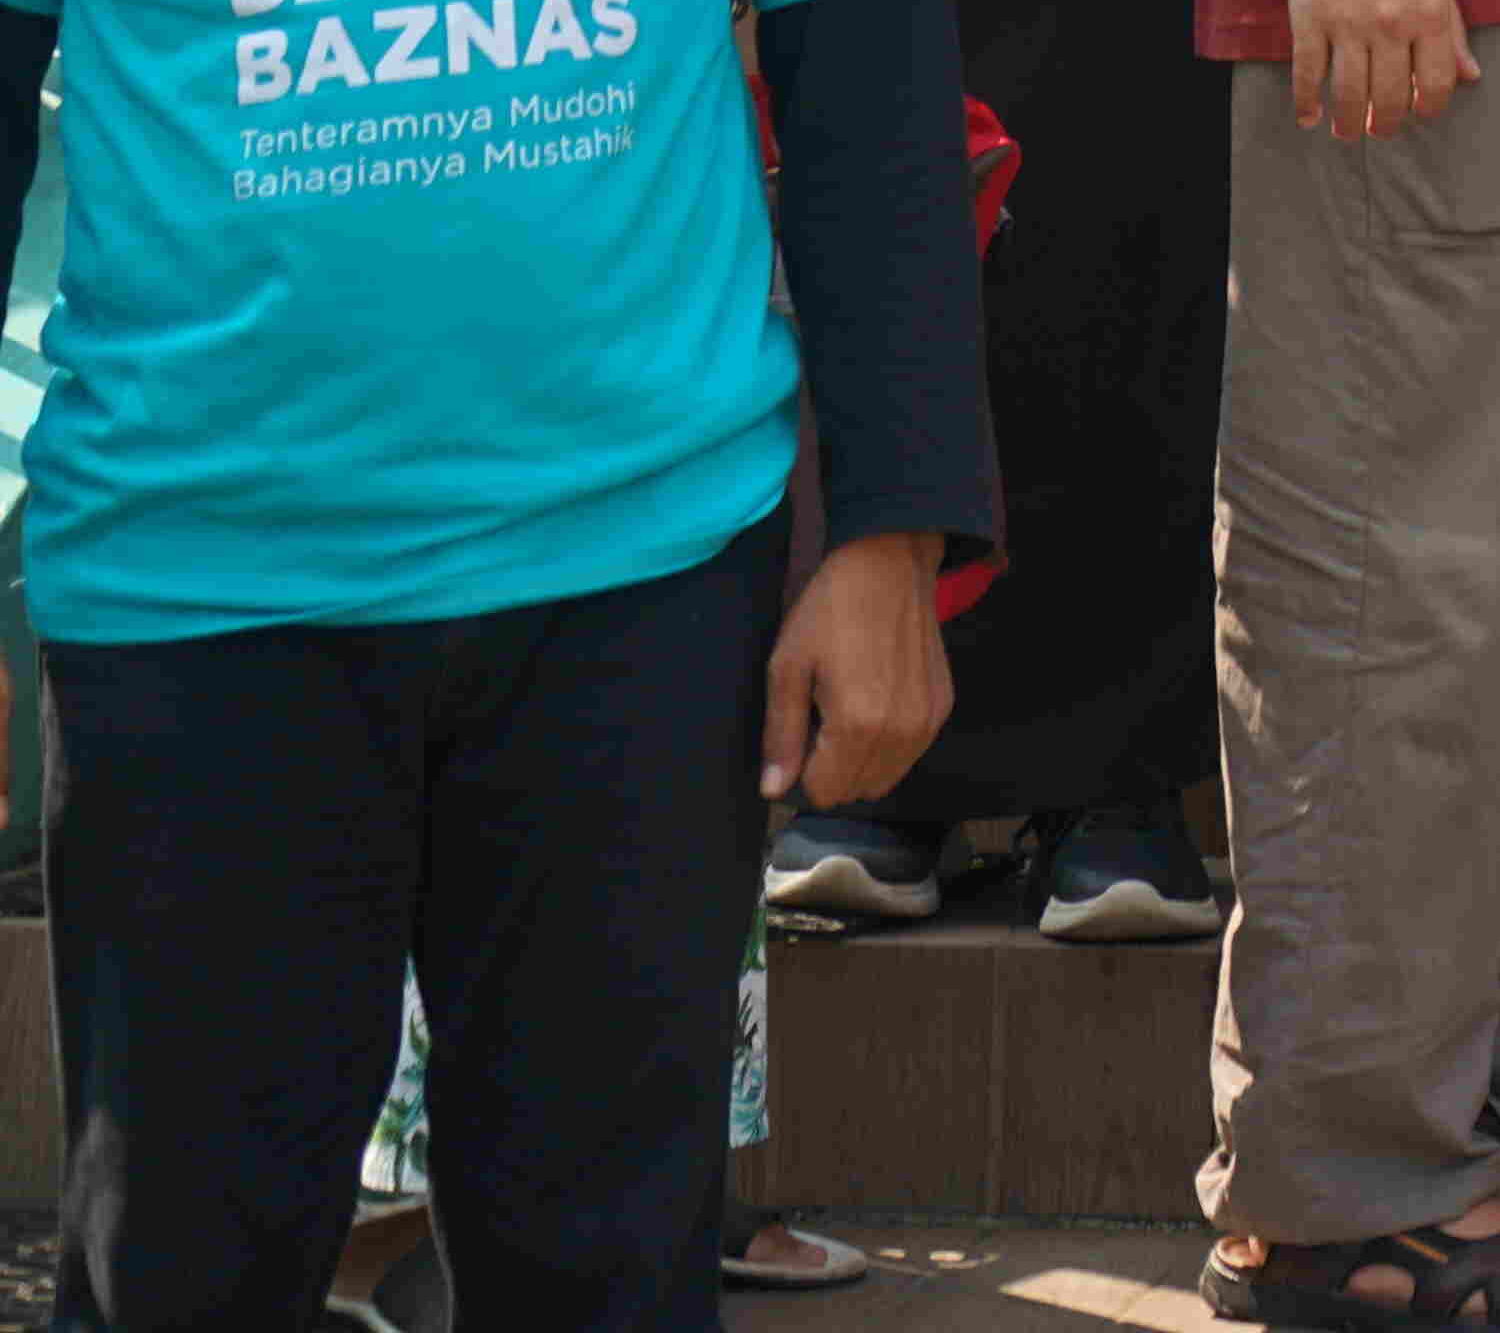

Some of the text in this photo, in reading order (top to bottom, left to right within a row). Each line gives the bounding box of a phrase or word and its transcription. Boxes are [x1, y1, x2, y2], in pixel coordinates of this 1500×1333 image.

[240, 81, 637, 159] Tenteramnya Mudohi
[233, 126, 634, 201] Bahagianya Mustahik
